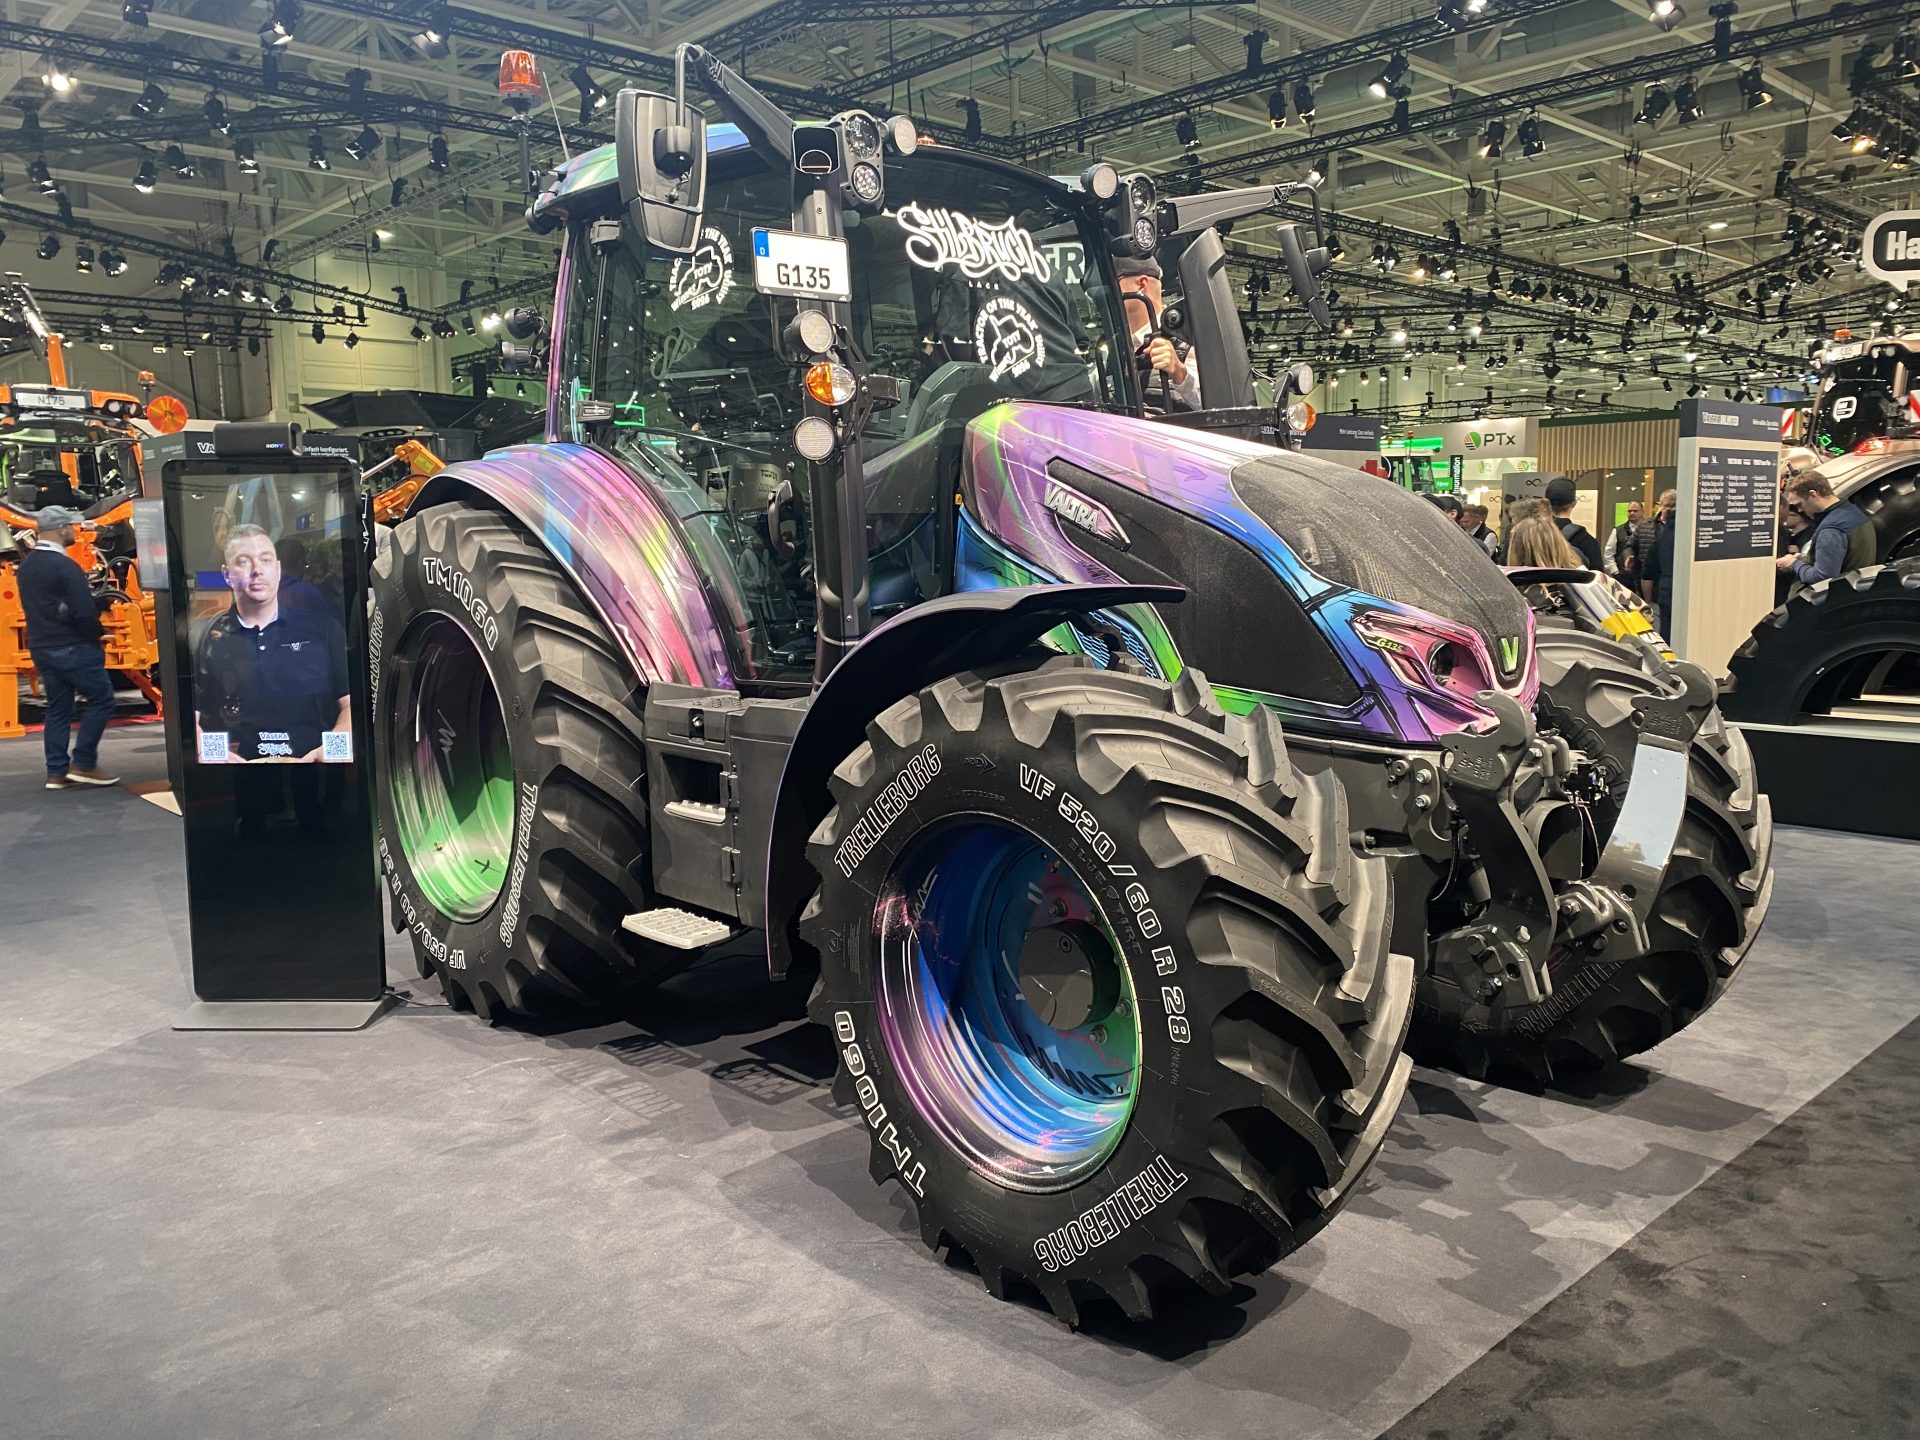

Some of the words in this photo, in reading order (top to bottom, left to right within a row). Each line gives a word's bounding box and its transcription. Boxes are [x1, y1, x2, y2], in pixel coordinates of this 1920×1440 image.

[705, 228, 720, 241] THE
[759, 246, 766, 255] D
[776, 262, 831, 290] G135
[975, 309, 989, 364] TRACTOR
[985, 299, 997, 314] OF
[997, 297, 1015, 311] THE
[1016, 302, 1039, 331] YEAR
[37, 396, 65, 406] N175
[1483, 432, 1516, 446] PTx
[1044, 482, 1099, 534] VALTRA
[422, 557, 499, 652] TM1060
[1020, 763, 1056, 800] VF
[834, 743, 942, 878] TRELLEBORG
[500, 782, 539, 948] TRELLEBORG
[1058, 791, 1162, 939] 520/60
[449, 949, 467, 969] VF
[1151, 945, 1178, 977] R
[1161, 986, 1190, 1044] 28
[834, 1010, 927, 1198] TM1060
[1033, 1154, 1189, 1272] TRELLEBORG
